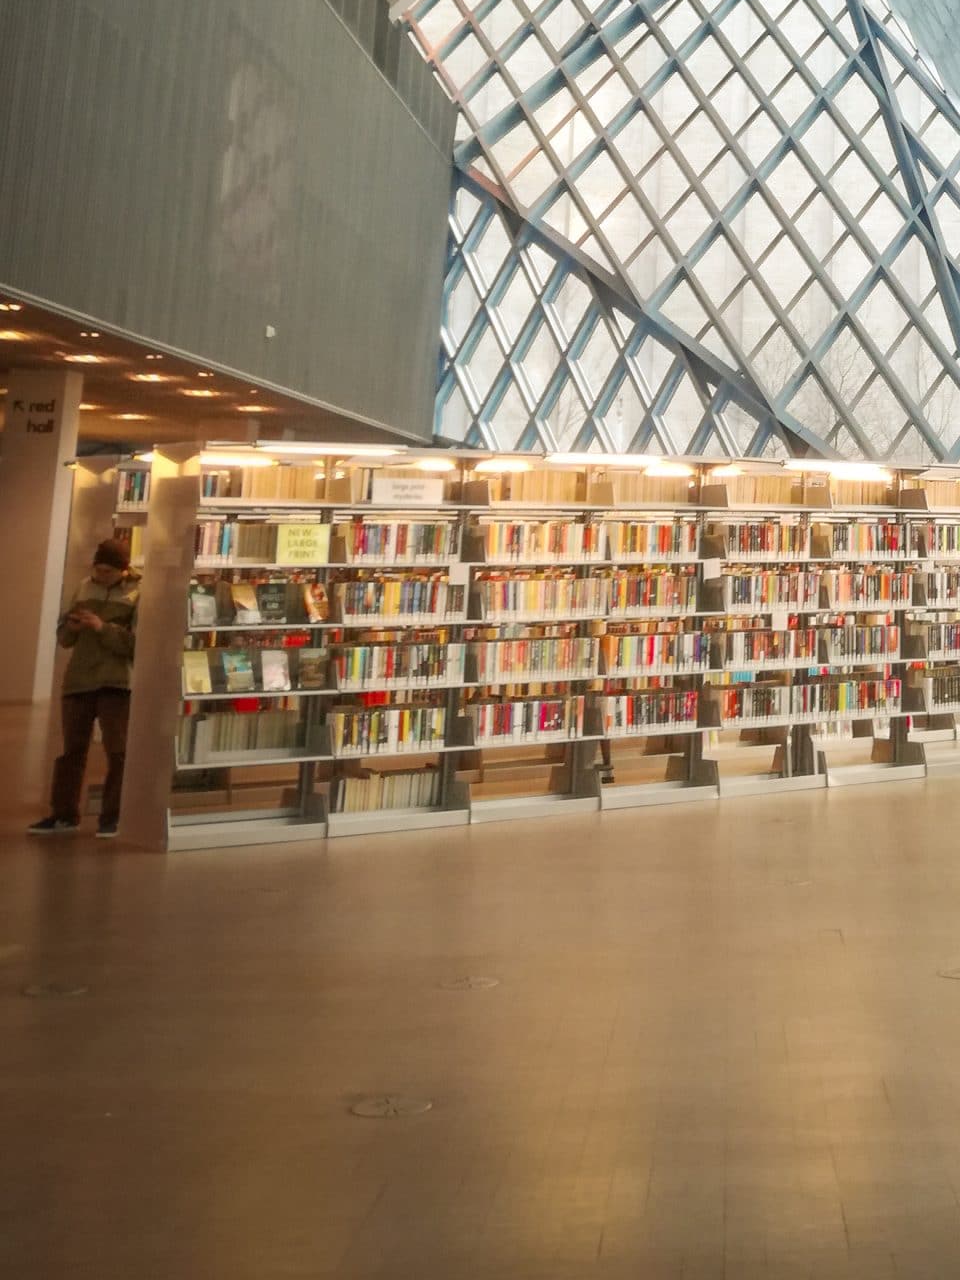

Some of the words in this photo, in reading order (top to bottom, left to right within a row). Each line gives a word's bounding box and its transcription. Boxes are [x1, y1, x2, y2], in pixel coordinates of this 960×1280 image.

[29, 398, 56, 413] red
[27, 418, 54, 433] hall
[287, 528, 312, 537] NEW
[287, 539, 319, 549] LARGE
